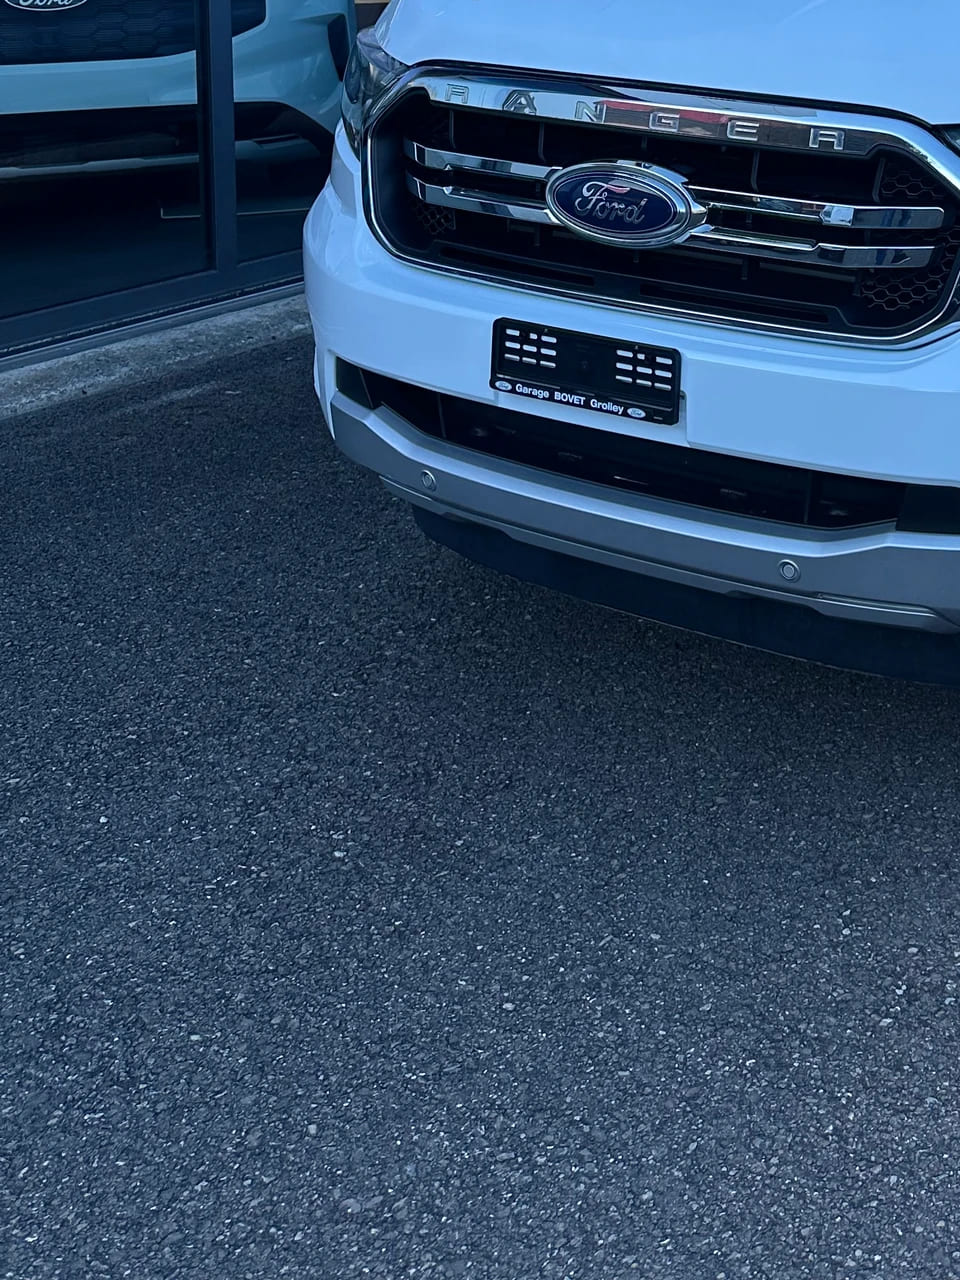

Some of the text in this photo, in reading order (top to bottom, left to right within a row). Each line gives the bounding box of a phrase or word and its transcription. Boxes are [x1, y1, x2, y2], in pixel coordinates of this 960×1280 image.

[444, 83, 844, 151] RANGER
[574, 181, 648, 224] Ford
[515, 383, 550, 399] Garage
[554, 391, 586, 405] BOVET
[590, 399, 624, 415] Grolley
